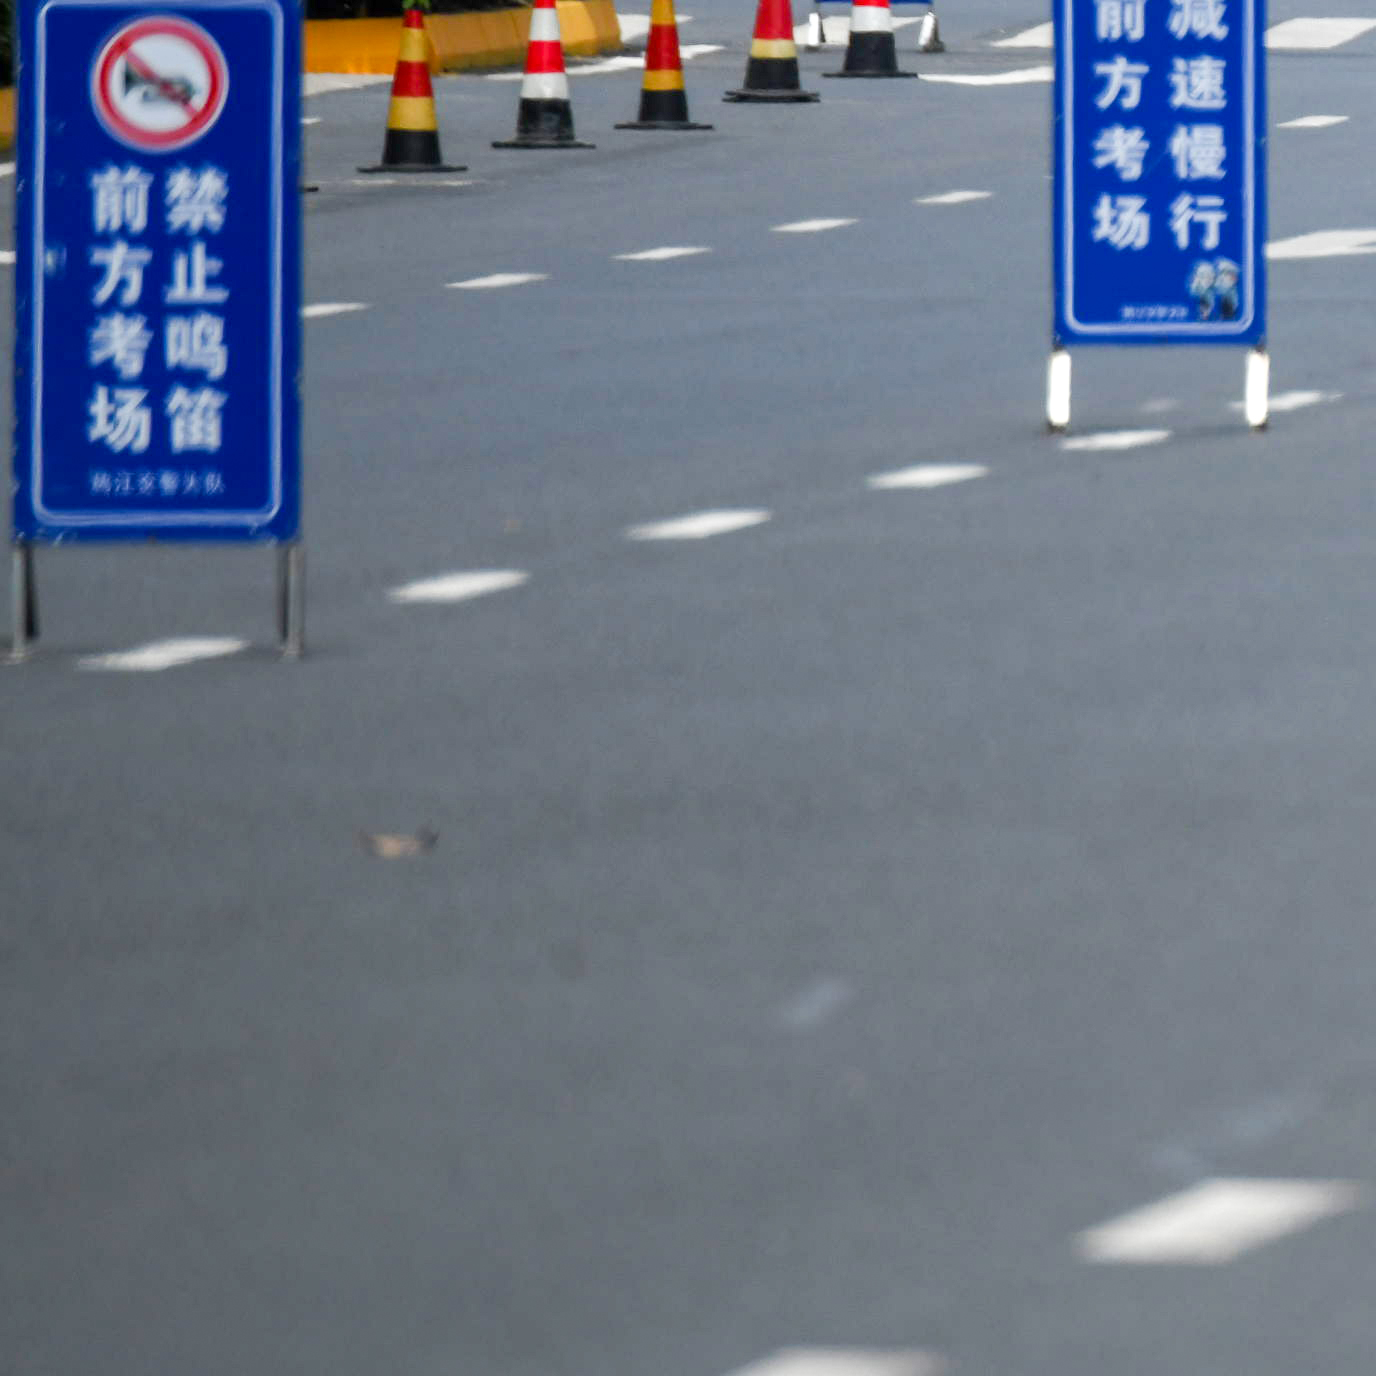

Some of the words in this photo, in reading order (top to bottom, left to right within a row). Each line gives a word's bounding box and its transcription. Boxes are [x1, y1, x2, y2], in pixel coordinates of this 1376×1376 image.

[90, 165, 154, 454] 前方考场
[165, 166, 229, 454] 禁止鸣笛
